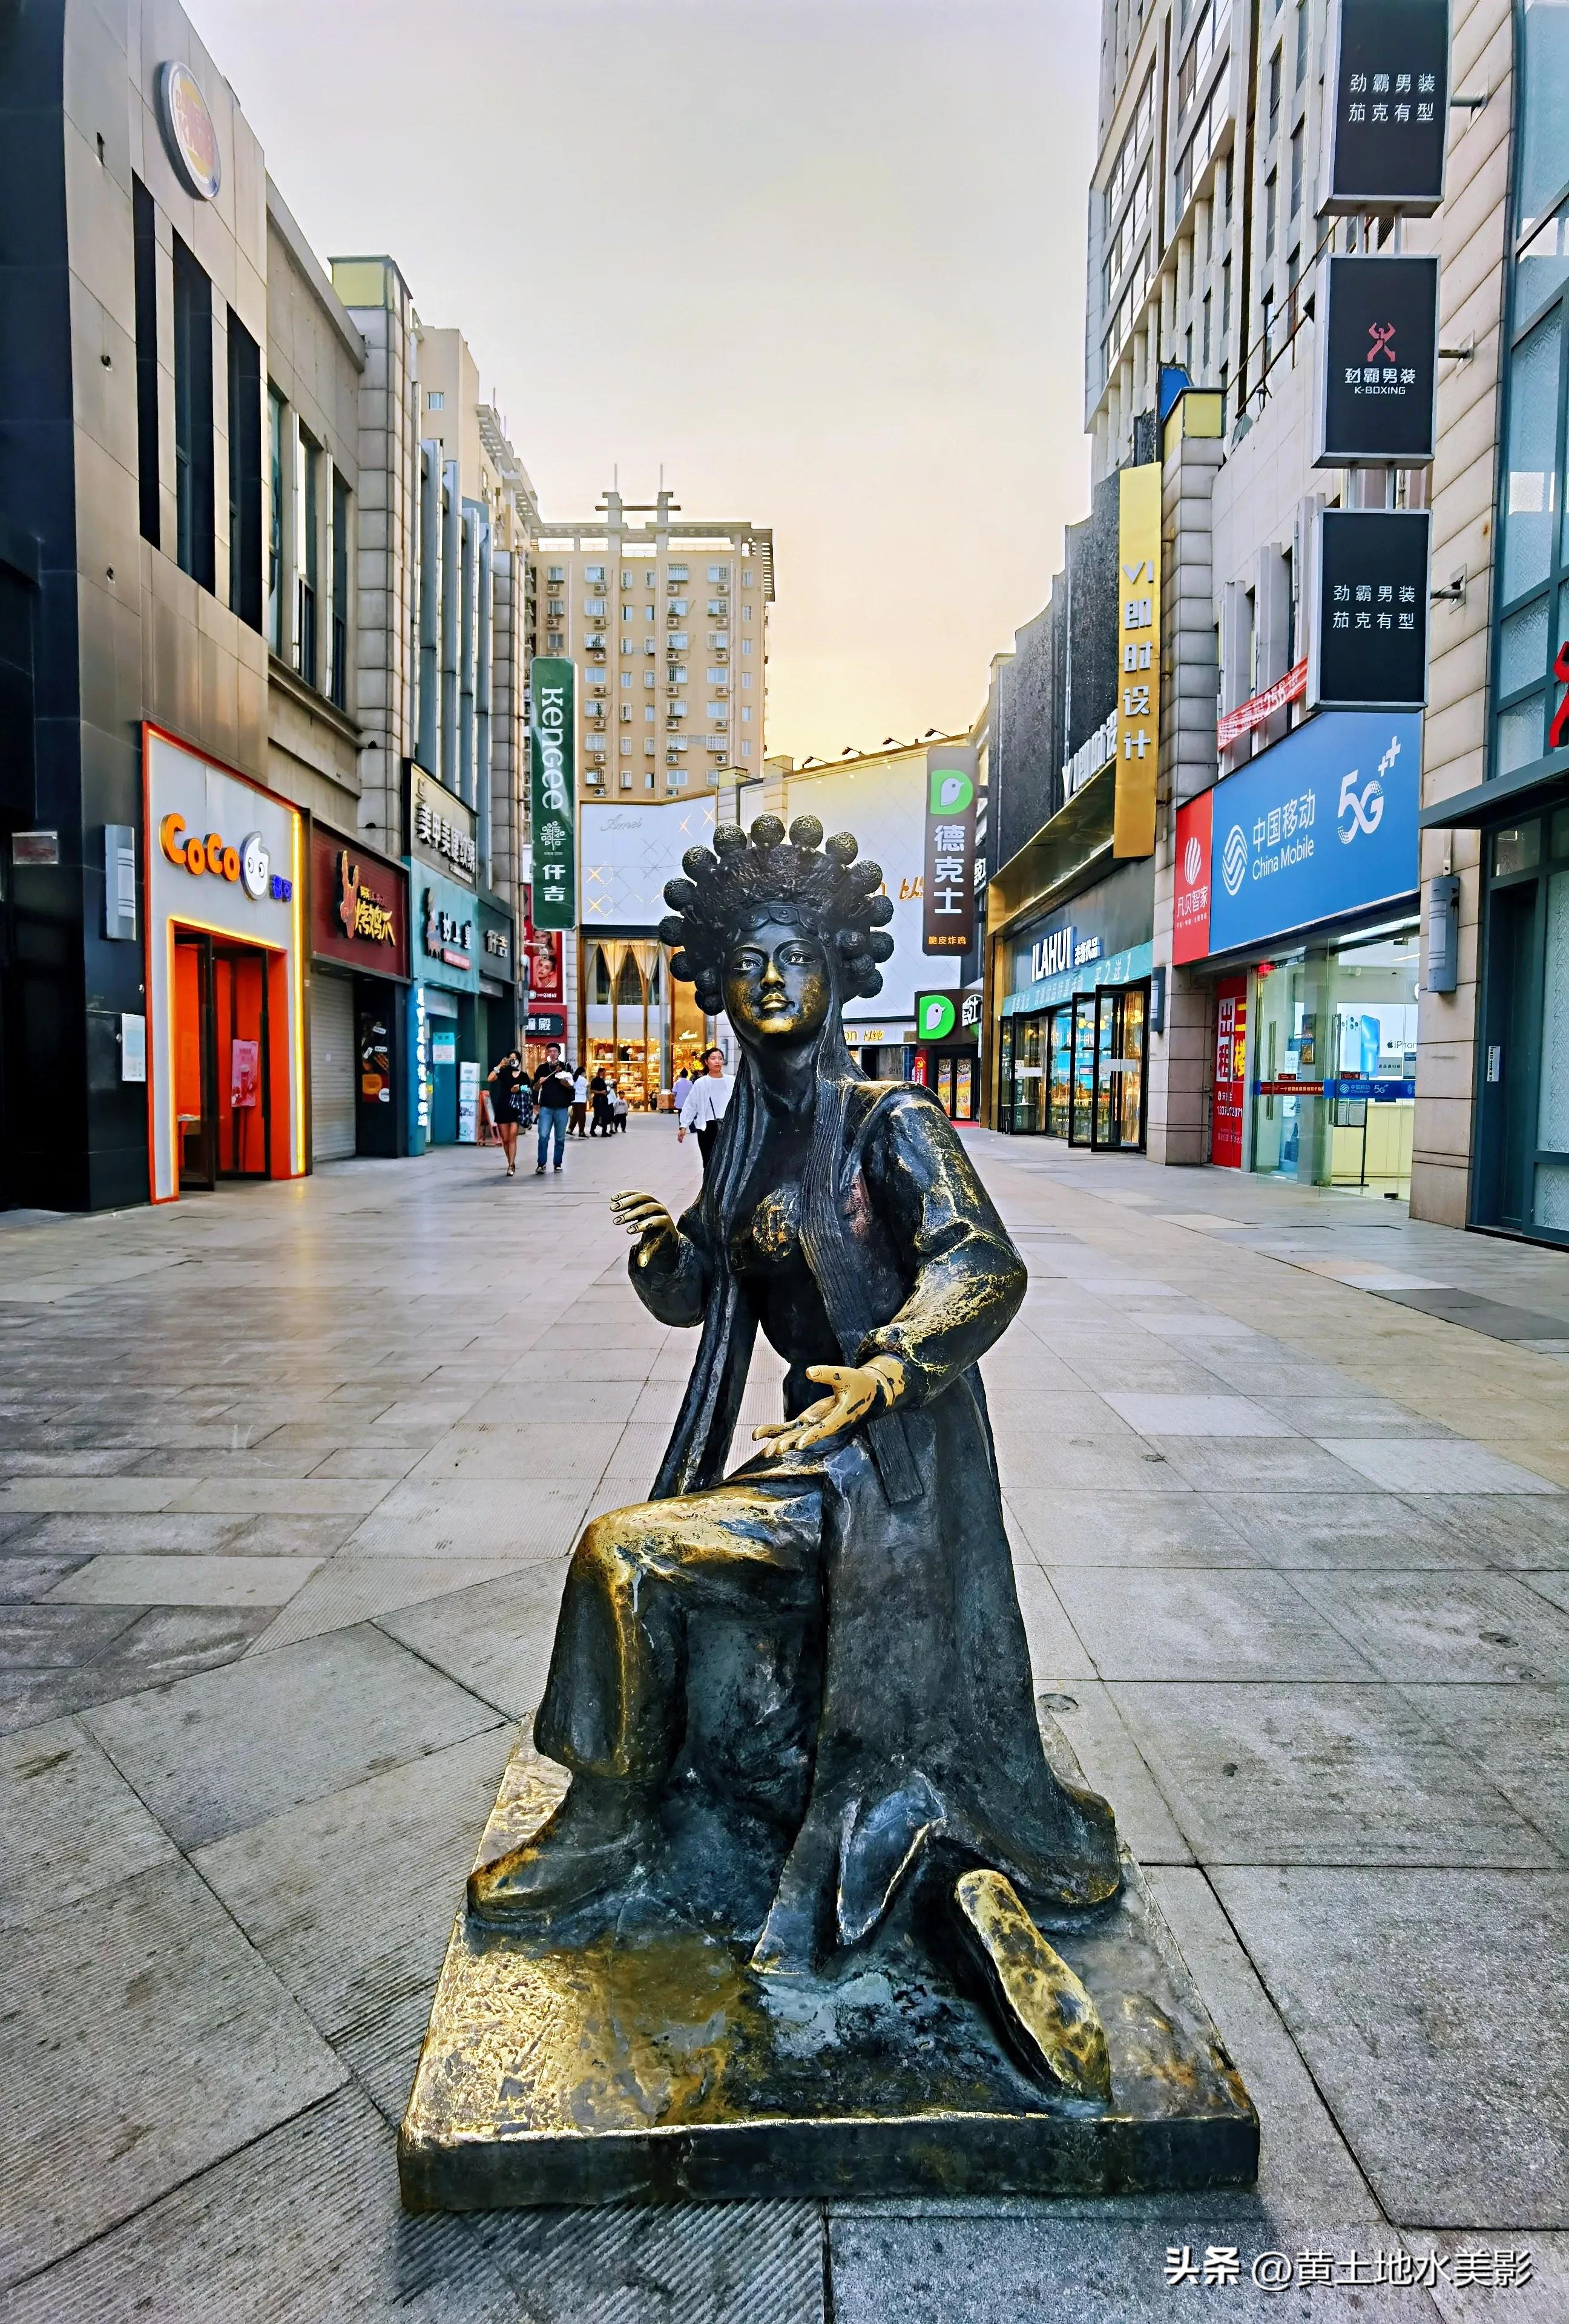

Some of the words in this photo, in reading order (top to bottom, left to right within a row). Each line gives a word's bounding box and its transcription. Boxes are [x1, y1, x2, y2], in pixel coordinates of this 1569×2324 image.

[1349, 73, 1435, 93] 劲霸男装
[1348, 102, 1434, 122] 茄克有型
[1344, 367, 1416, 384] 劲霸男装
[1354, 386, 1406, 395] K-BOXING
[1333, 585, 1416, 603] 劲霸男装
[1332, 612, 1415, 629] 茄克有型
[1252, 789, 1315, 854] 中国移动
[159, 812, 240, 882] CoCo
[934, 824, 965, 914] 德克士
[1252, 854, 1278, 881] China
[1281, 838, 1314, 869] Mobile
[542, 864, 566, 901] 仟吉
[928, 936, 967, 945] 脆皮炸鸡
[1031, 926, 1073, 982] ILAHUI
